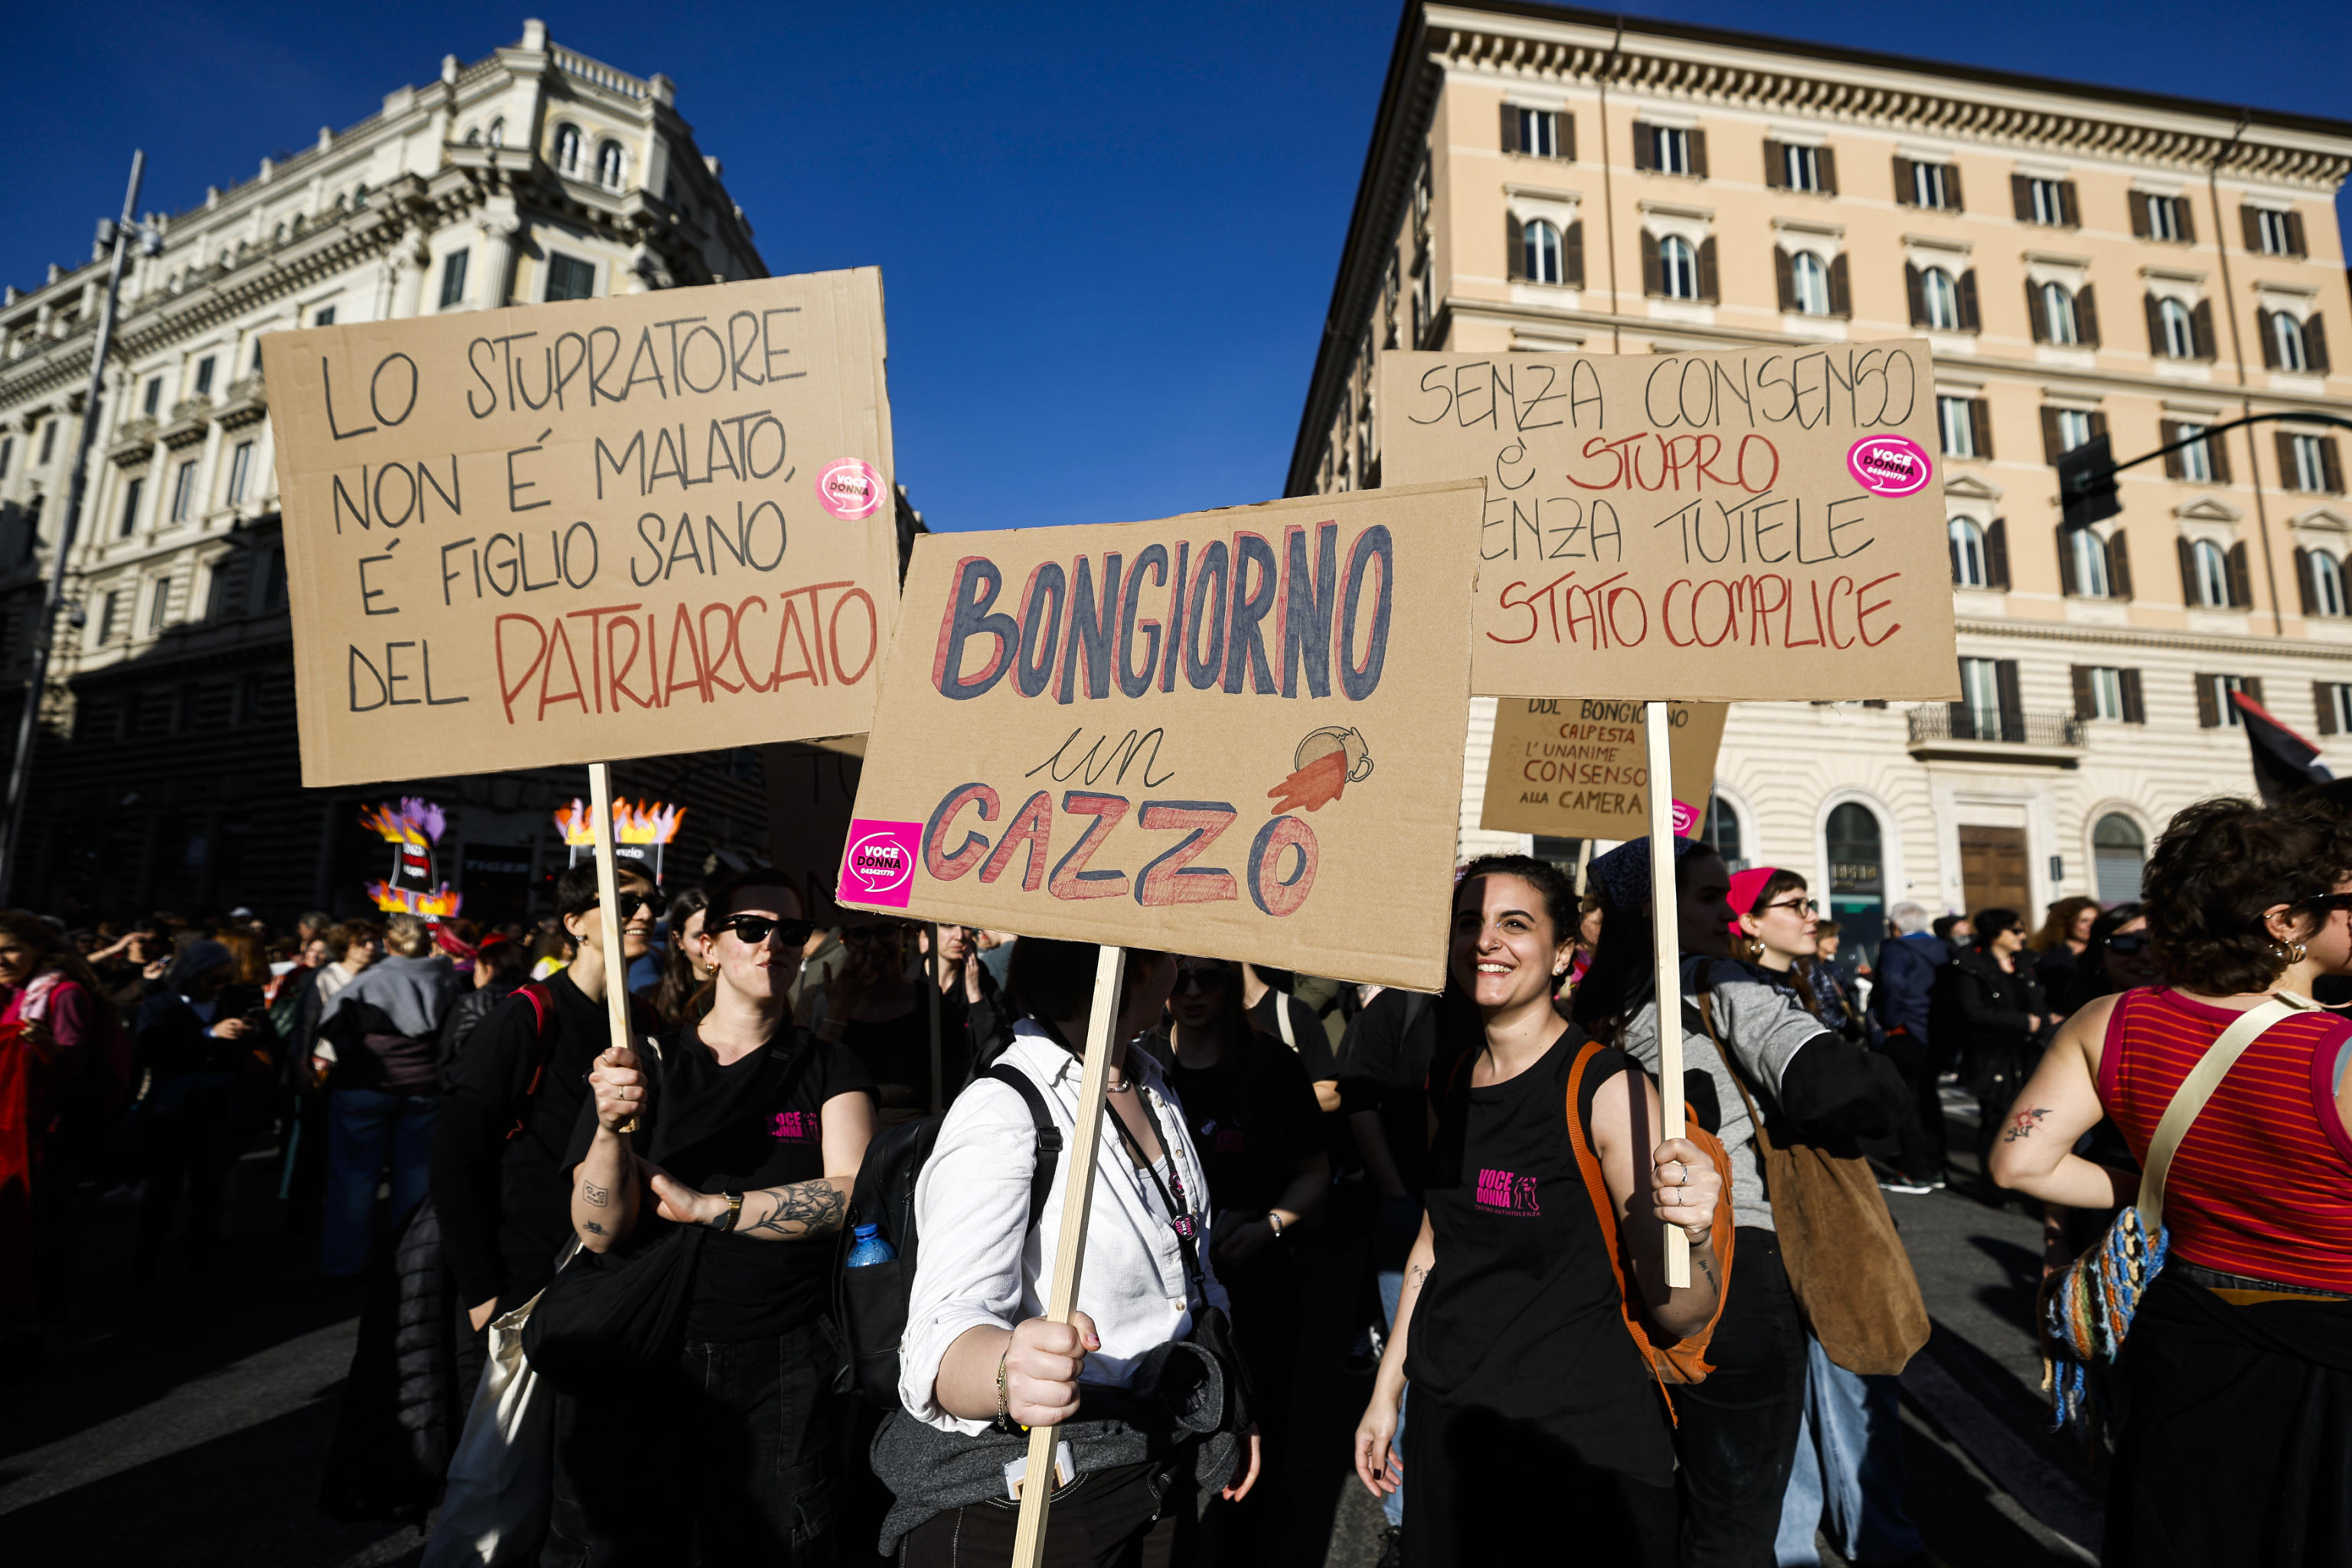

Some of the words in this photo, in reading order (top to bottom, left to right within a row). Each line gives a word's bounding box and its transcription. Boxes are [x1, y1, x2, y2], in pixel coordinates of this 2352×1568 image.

[322, 351, 418, 440] LO
[467, 306, 807, 420] STUPRATORE
[1408, 358, 1604, 431] SENZA
[1645, 348, 1915, 430] CONSENSO
[1566, 431, 1779, 494] STUPRO
[1863, 455, 1915, 475] DONNA
[1873, 447, 1913, 466] VOCE
[333, 453, 461, 534] NON
[595, 410, 796, 500] MALATO,
[836, 475, 867, 488] VOCE
[829, 482, 869, 496] DONNA
[1480, 497, 1622, 563] ENZA
[1654, 490, 1875, 564] TUTELE
[441, 521, 598, 606] FIGLIO
[631, 500, 787, 586] SANO
[931, 519, 1392, 704] BONGIORNO
[1486, 570, 1648, 651] STATO
[1662, 571, 1902, 649] COMPLICE
[349, 639, 469, 712] DEL
[495, 580, 877, 725] PATRIARCATO
[1528, 698, 1561, 715] DDL
[1581, 700, 1688, 728] BONGIONO
[1560, 723, 1635, 744] CALPESTA
[1024, 727, 1174, 788] un
[1544, 742, 1620, 762] UNANIME
[1524, 760, 1648, 787] CONSENSO
[1559, 790, 1643, 815] CAMERA
[864, 845, 899, 858] VOCE
[922, 782, 1318, 916] CAZZO
[858, 856, 901, 869] DONNA
[860, 867, 895, 877] 043421779
[771, 1111, 801, 1125] OCE
[1478, 1168, 1514, 1191] VOCE
[1476, 1187, 1511, 1208] DONNA
[1184, 1217, 1193, 1236] FIGHT
